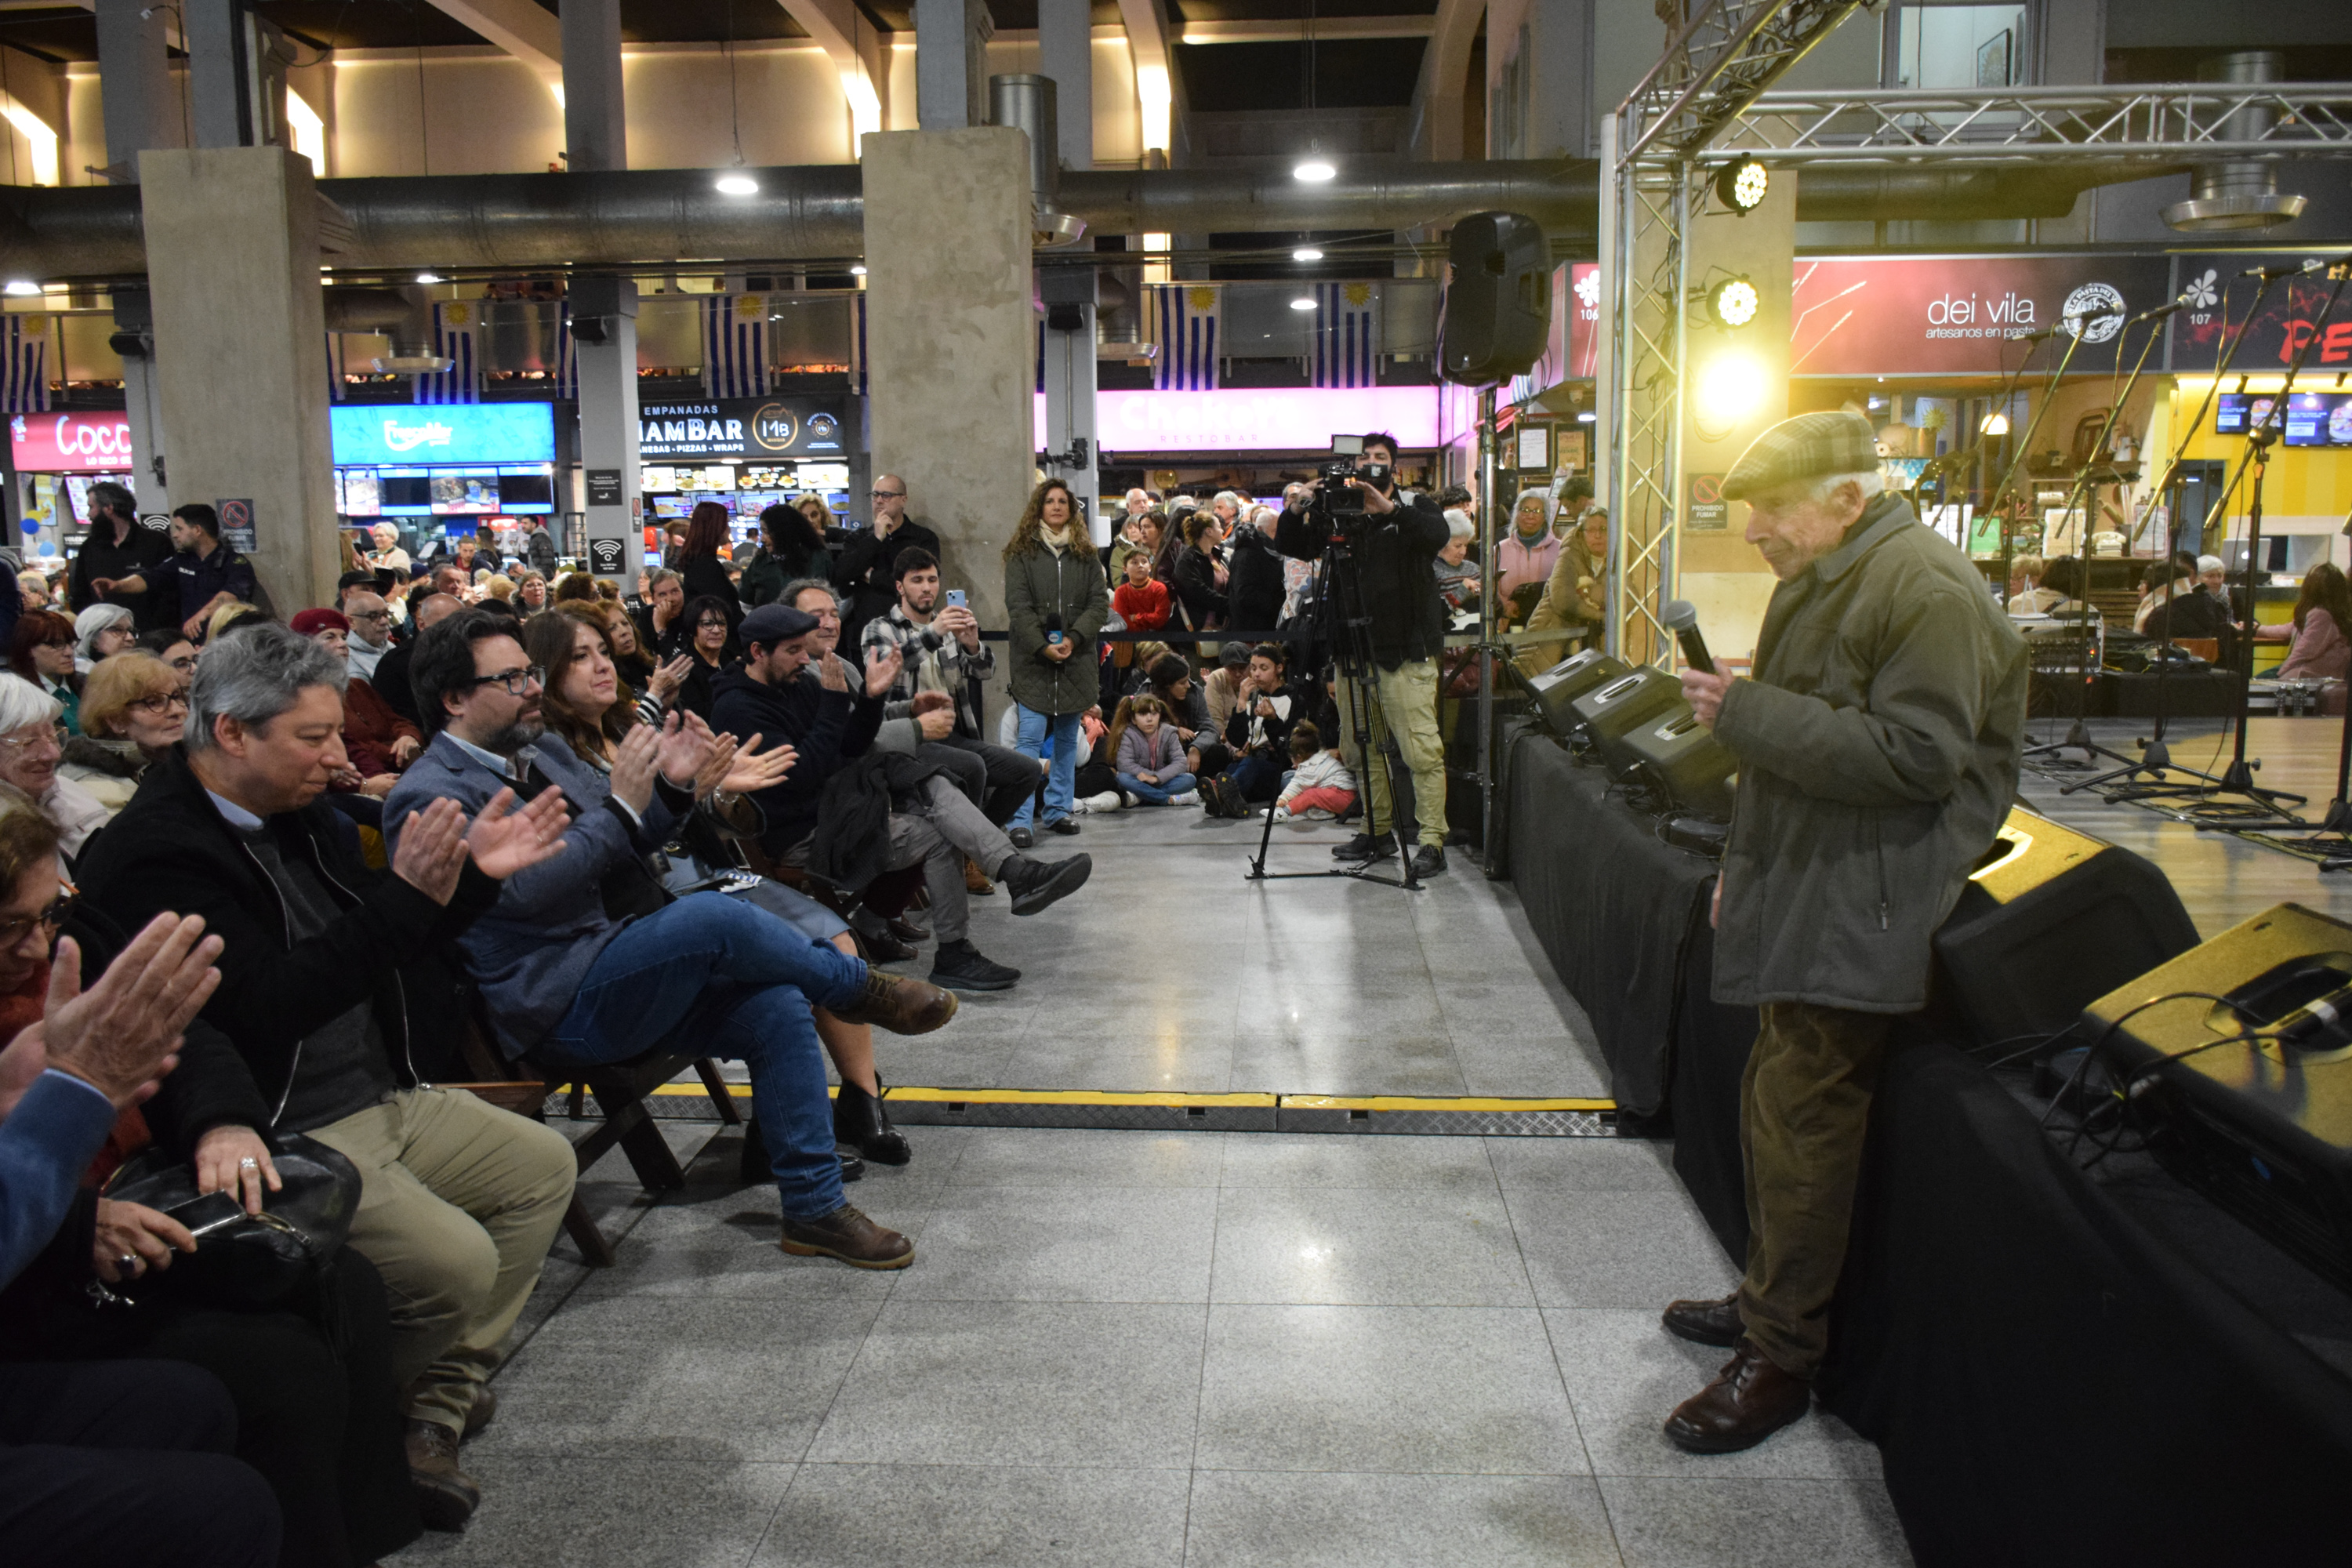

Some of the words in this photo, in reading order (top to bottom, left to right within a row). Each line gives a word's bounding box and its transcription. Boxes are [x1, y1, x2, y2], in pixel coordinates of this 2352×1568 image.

[2070, 298, 2078, 310] LA
[2076, 287, 2099, 299] PASTA
[1581, 308, 1599, 321] 106
[1927, 292, 1976, 325] dei
[1986, 292, 2035, 324] vila
[2190, 314, 2211, 325] 107
[1926, 327, 1982, 339] artesanos
[1985, 328, 2000, 338] en
[644, 405, 718, 416] EMPANADAS
[639, 419, 744, 442] AMBAR
[1160, 434, 1258, 444] RESTOBAR
[639, 445, 670, 454] NESAS
